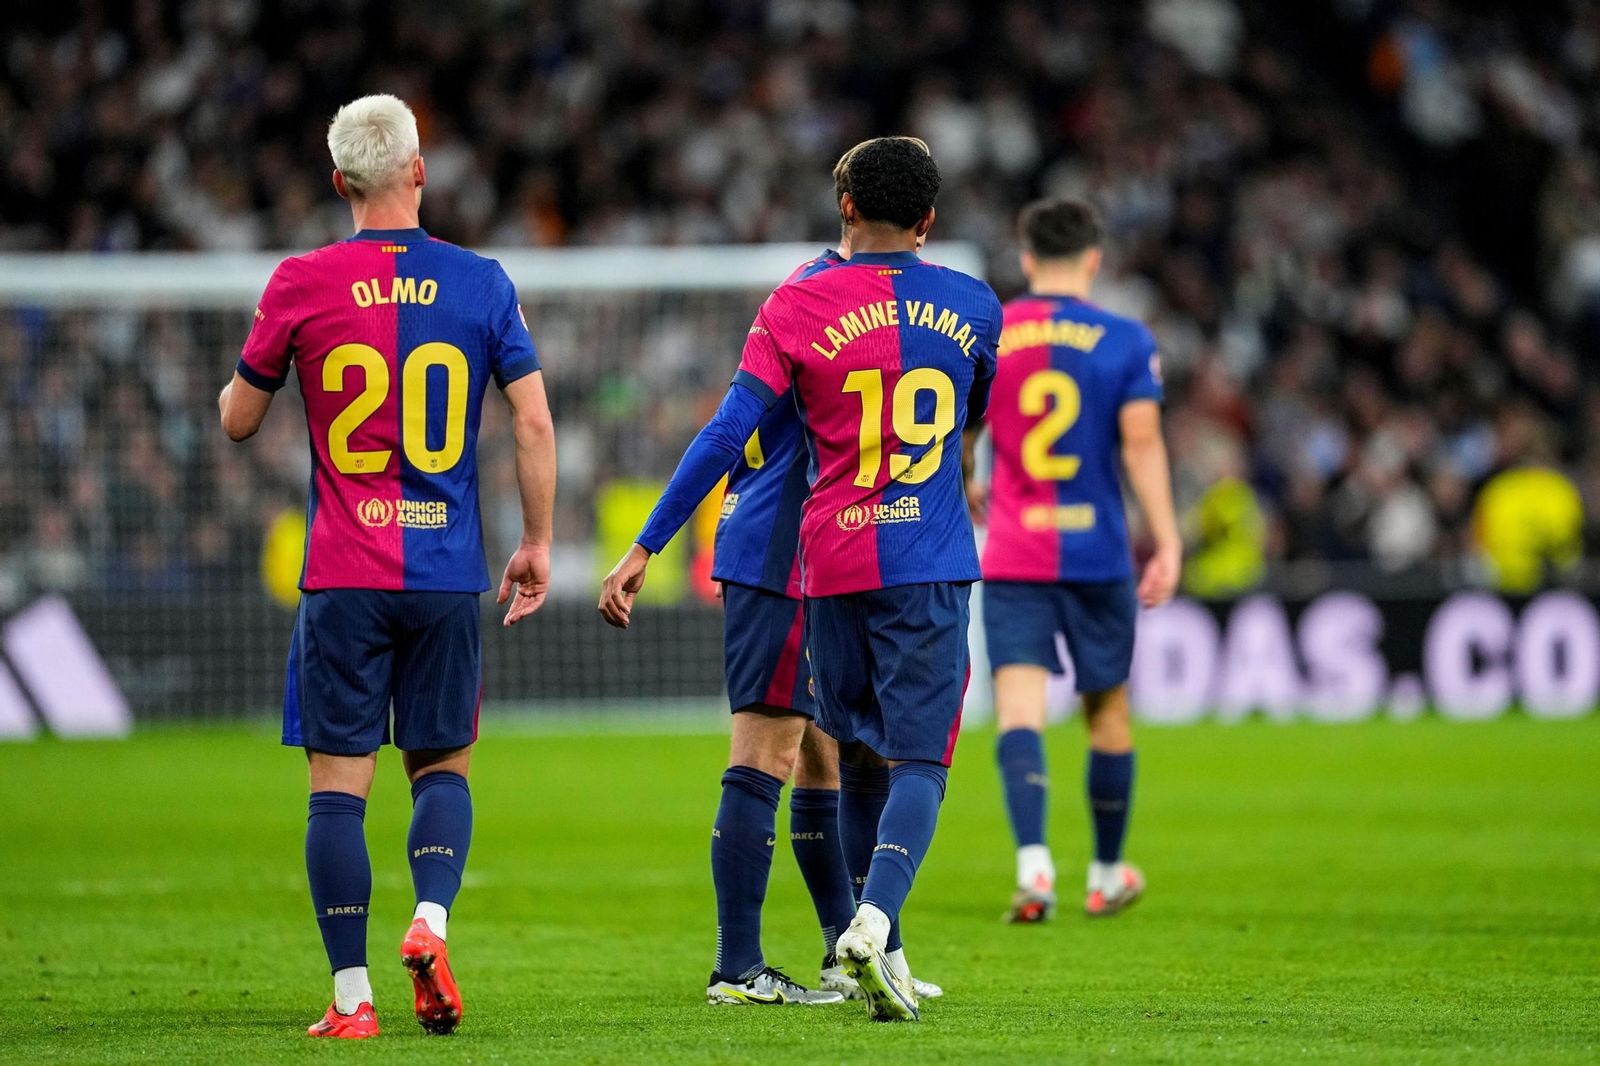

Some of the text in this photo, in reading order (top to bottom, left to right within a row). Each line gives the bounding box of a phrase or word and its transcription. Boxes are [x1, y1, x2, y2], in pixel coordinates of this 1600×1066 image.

[351, 277, 438, 308] OLMO
[810, 300, 977, 361] LAMINE YAMAL
[322, 341, 470, 475] 20
[840, 367, 956, 489] 19
[1019, 369, 1082, 481] 2
[396, 499, 447, 514] UNHCR
[396, 511, 447, 524] ACNUR
